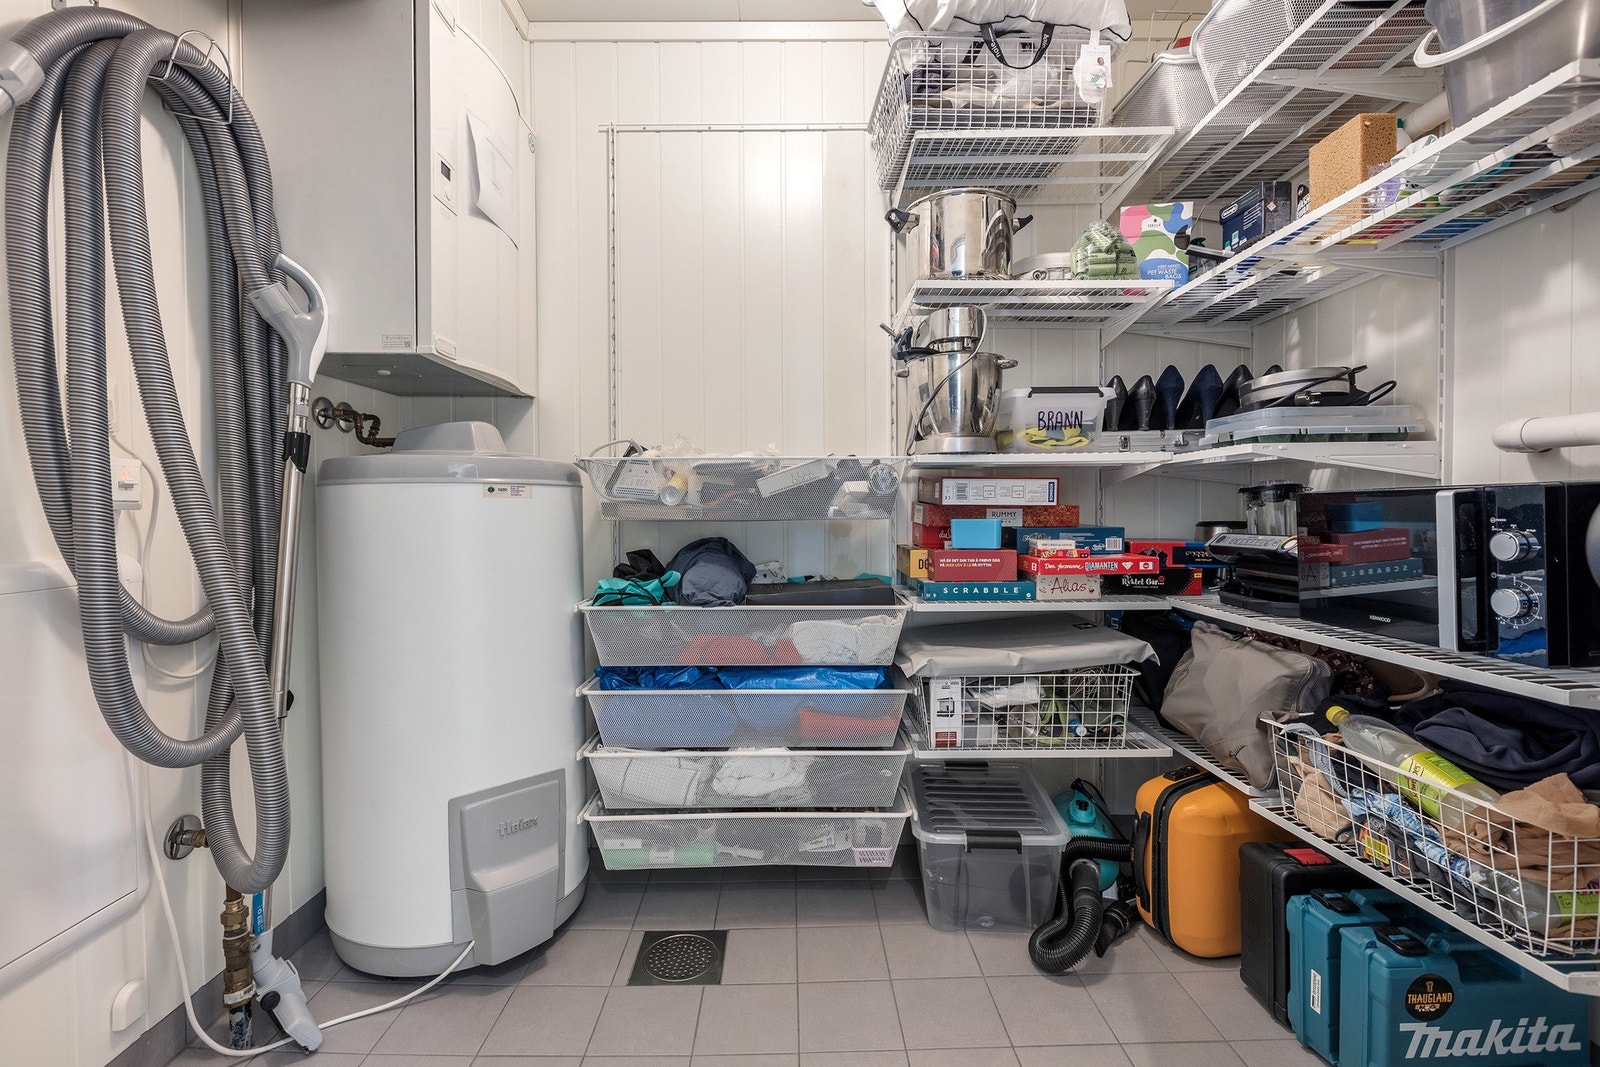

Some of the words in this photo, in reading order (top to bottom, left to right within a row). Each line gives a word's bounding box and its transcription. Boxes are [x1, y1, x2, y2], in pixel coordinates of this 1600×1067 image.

[1037, 410, 1083, 431] BRANN
[1085, 562, 1118, 571] DIAMANTEN
[1051, 577, 1087, 594] Alias
[1407, 992, 1453, 1004] THAUGLAND
[1400, 1016, 1581, 1059] Makita
